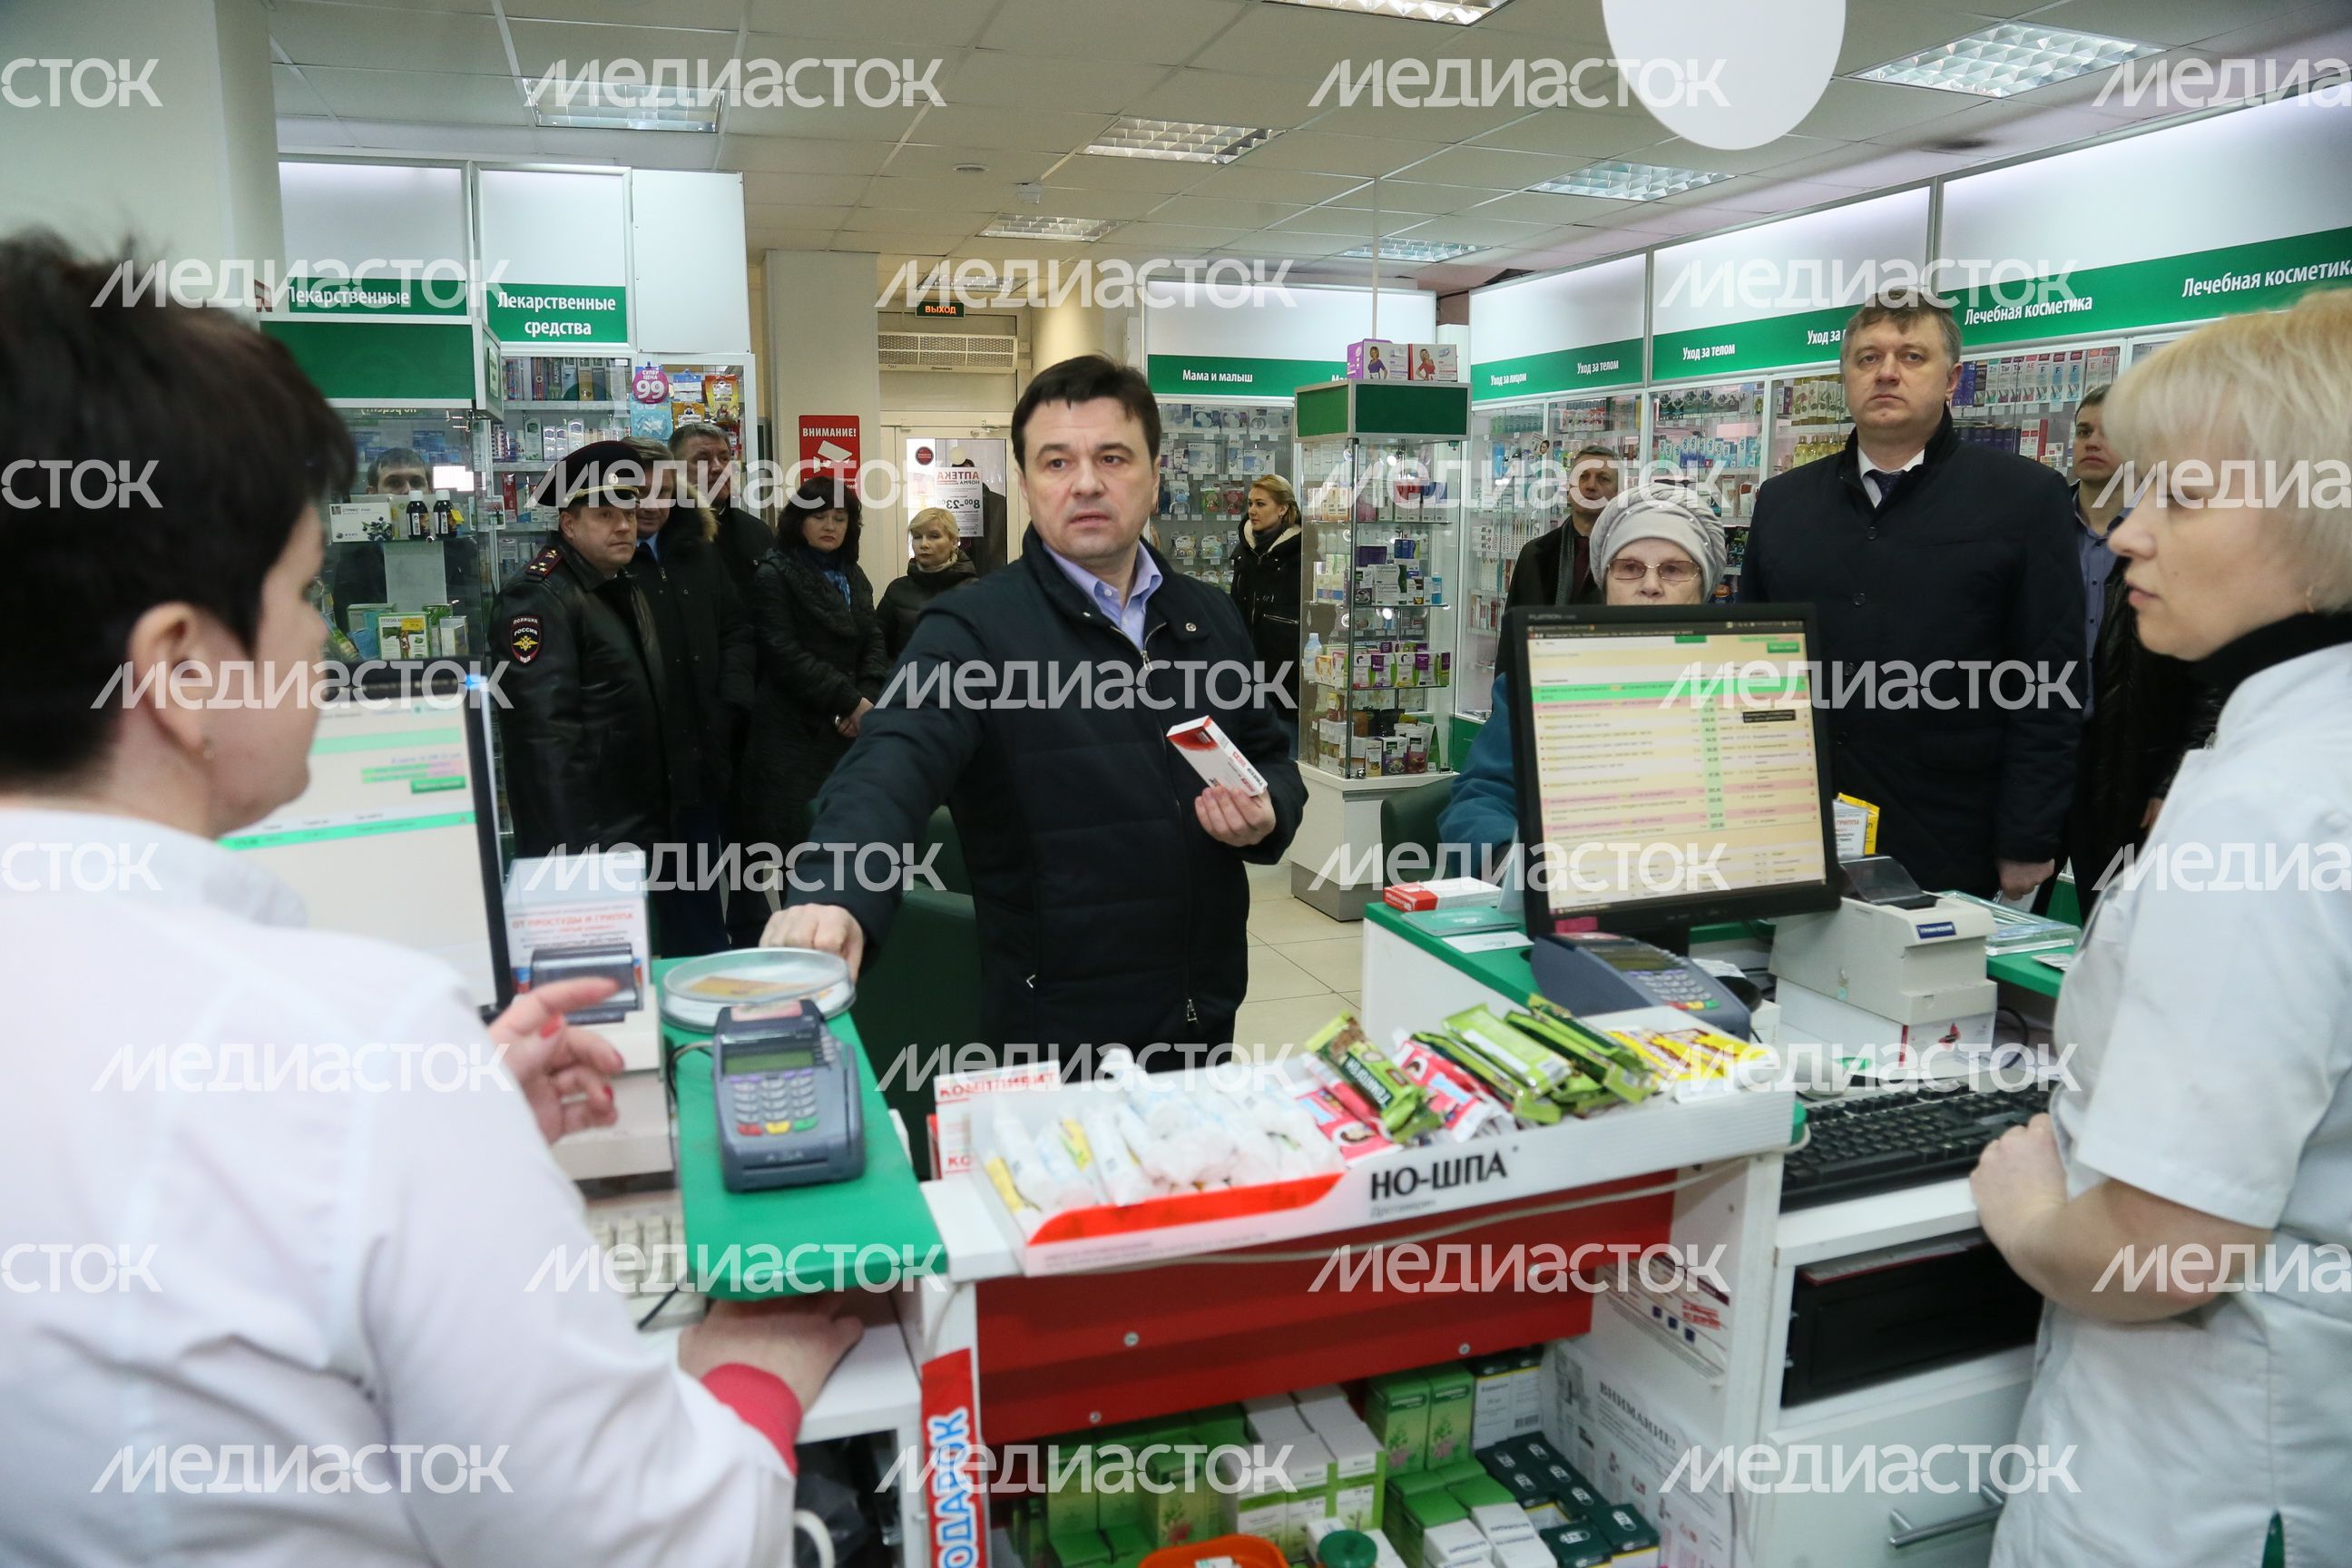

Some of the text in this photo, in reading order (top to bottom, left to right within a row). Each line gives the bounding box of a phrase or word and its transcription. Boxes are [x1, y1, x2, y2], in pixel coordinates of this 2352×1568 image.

[2181, 271, 2260, 298] Лечебная
[289, 285, 410, 307] Лекарственные
[497, 291, 616, 312] Лекарственные
[925, 305, 957, 315] ВЫХОД
[1965, 296, 2092, 326] Лечебная косметика
[524, 319, 592, 338] средства
[1808, 329, 1828, 346] Уход
[1830, 330, 1841, 343] за
[1682, 344, 1735, 361] Уход за телом
[1182, 369, 1253, 383] Мама и малыш
[1577, 360, 1619, 375] Уход за телом
[1490, 375, 1504, 387] Уход
[1509, 372, 1527, 385] лицом
[636, 380, 665, 399] 99
[802, 427, 857, 437] ВНИМАНИЕ!
[513, 617, 538, 625] ПОЛИЦИЯ
[514, 627, 538, 636] РОССИЯ
[528, 916, 582, 927] ПРОСТУДЫ
[594, 913, 633, 922] ГРИППА
[1370, 1144, 1508, 1200] НО-ШПА
[1599, 1381, 1677, 1446] ВНИМАНИЕ!
